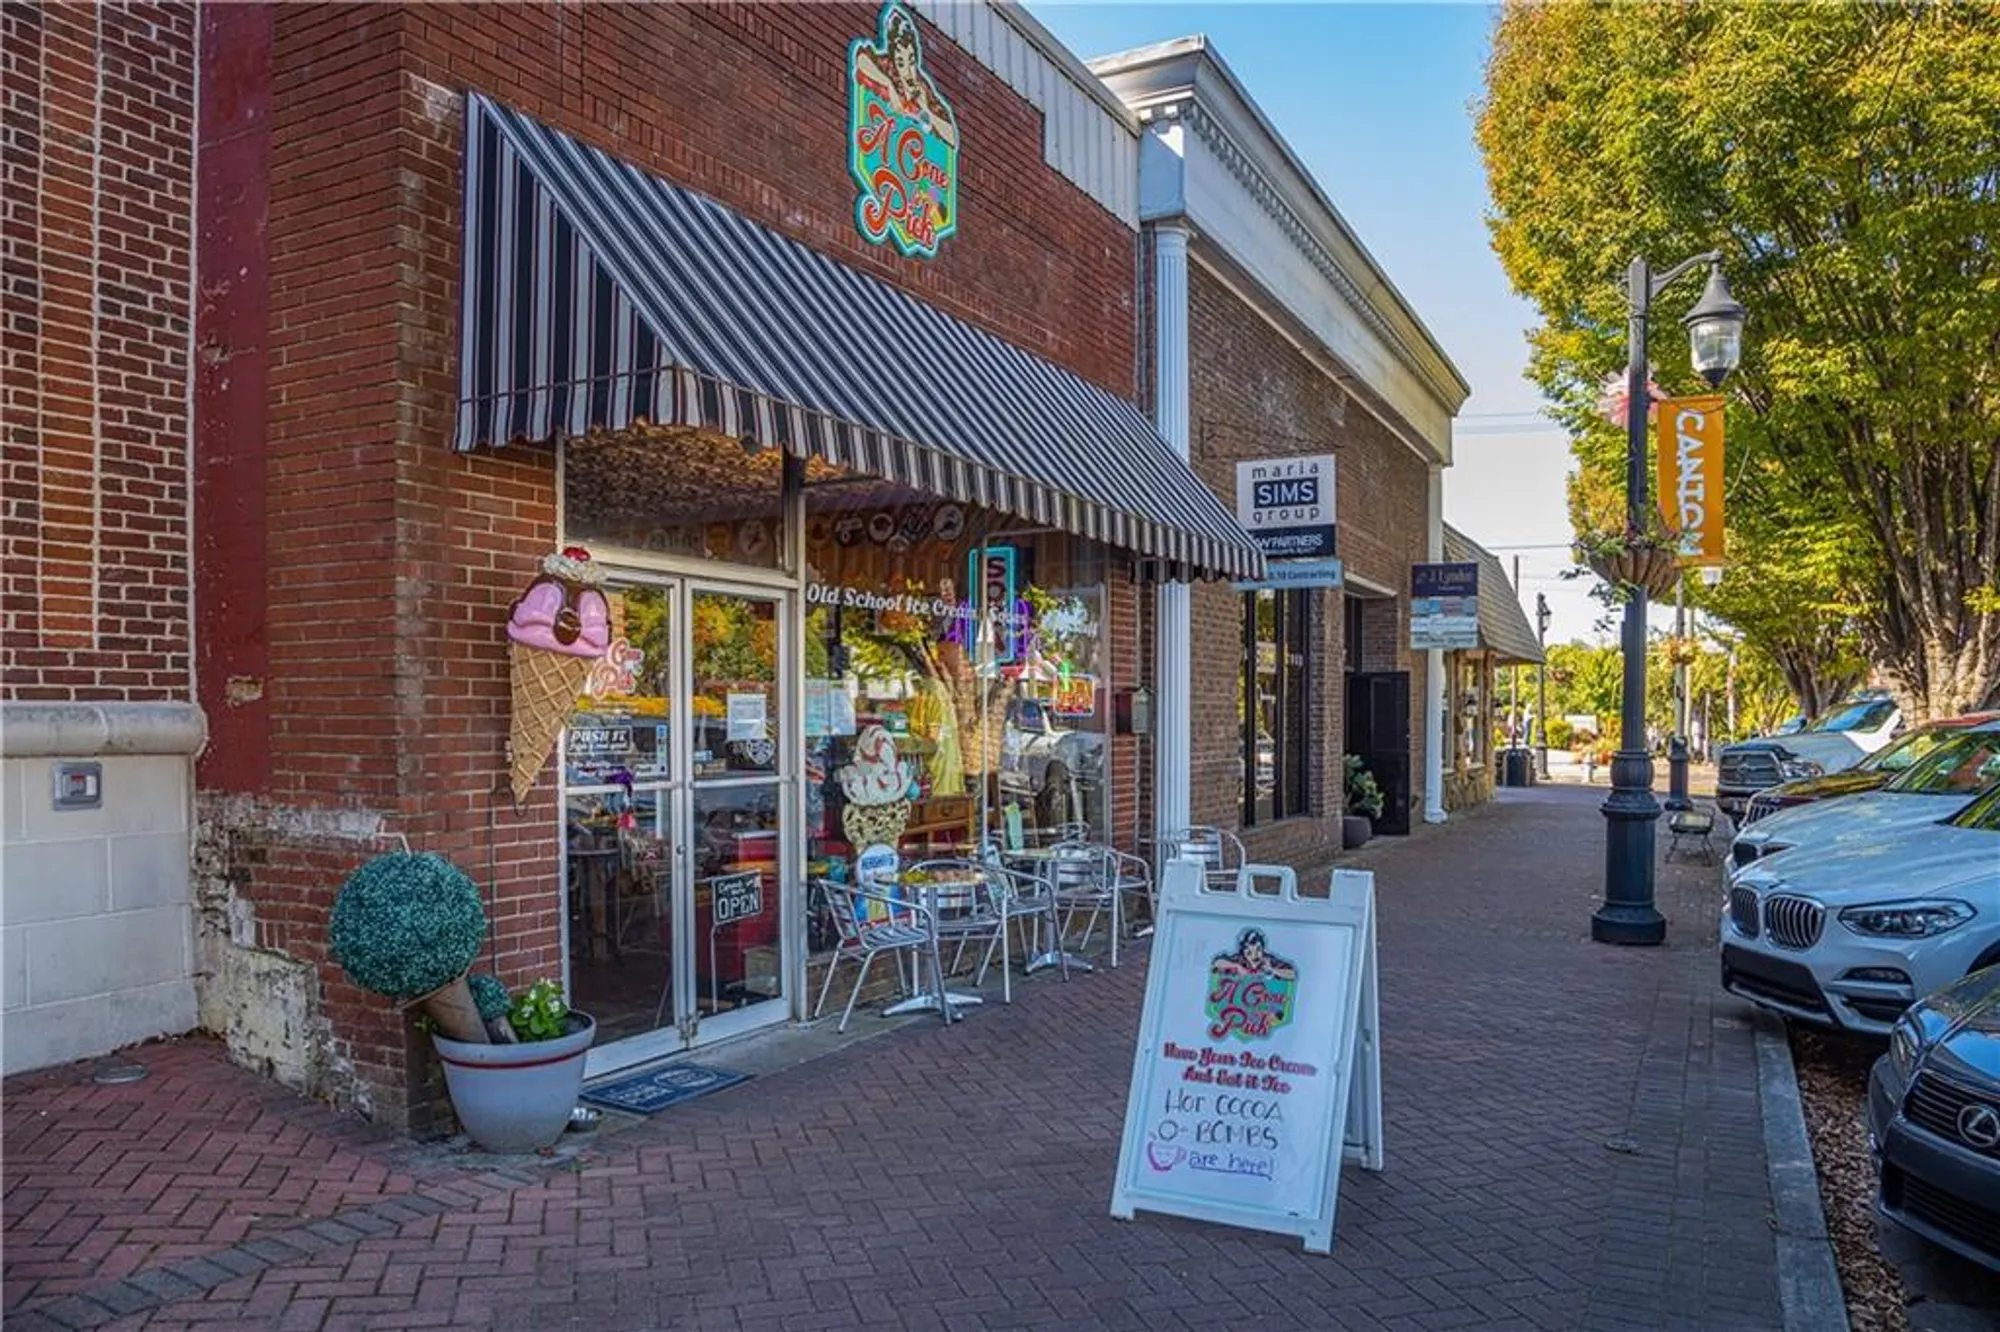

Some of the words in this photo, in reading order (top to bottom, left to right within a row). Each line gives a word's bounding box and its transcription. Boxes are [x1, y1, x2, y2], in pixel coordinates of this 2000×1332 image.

[857, 102, 896, 167] A
[863, 167, 936, 247] Pick
[1252, 460, 1319, 479] maria
[1676, 408, 1705, 556] CANTON
[1258, 481, 1314, 505] SIMS
[1252, 507, 1320, 524] group
[807, 583, 840, 605] Old
[843, 587, 905, 613] School
[906, 594, 931, 616] Ice
[570, 729, 610, 743] PUSH
[718, 894, 759, 919] OPEN
[1210, 978, 1239, 1003] A
[1163, 1042, 1198, 1060] Have
[1198, 1047, 1237, 1067] Your
[1239, 1051, 1267, 1070] Ice
[1268, 1054, 1318, 1076] Cream
[1182, 1065, 1213, 1083] And
[1216, 1069, 1244, 1088] Eat
[1245, 1072, 1260, 1089] it
[1260, 1074, 1292, 1094] Too
[1215, 1093, 1283, 1121] COCOA
[1195, 1120, 1279, 1150] BOMBS
[1190, 1151, 1218, 1166] are
